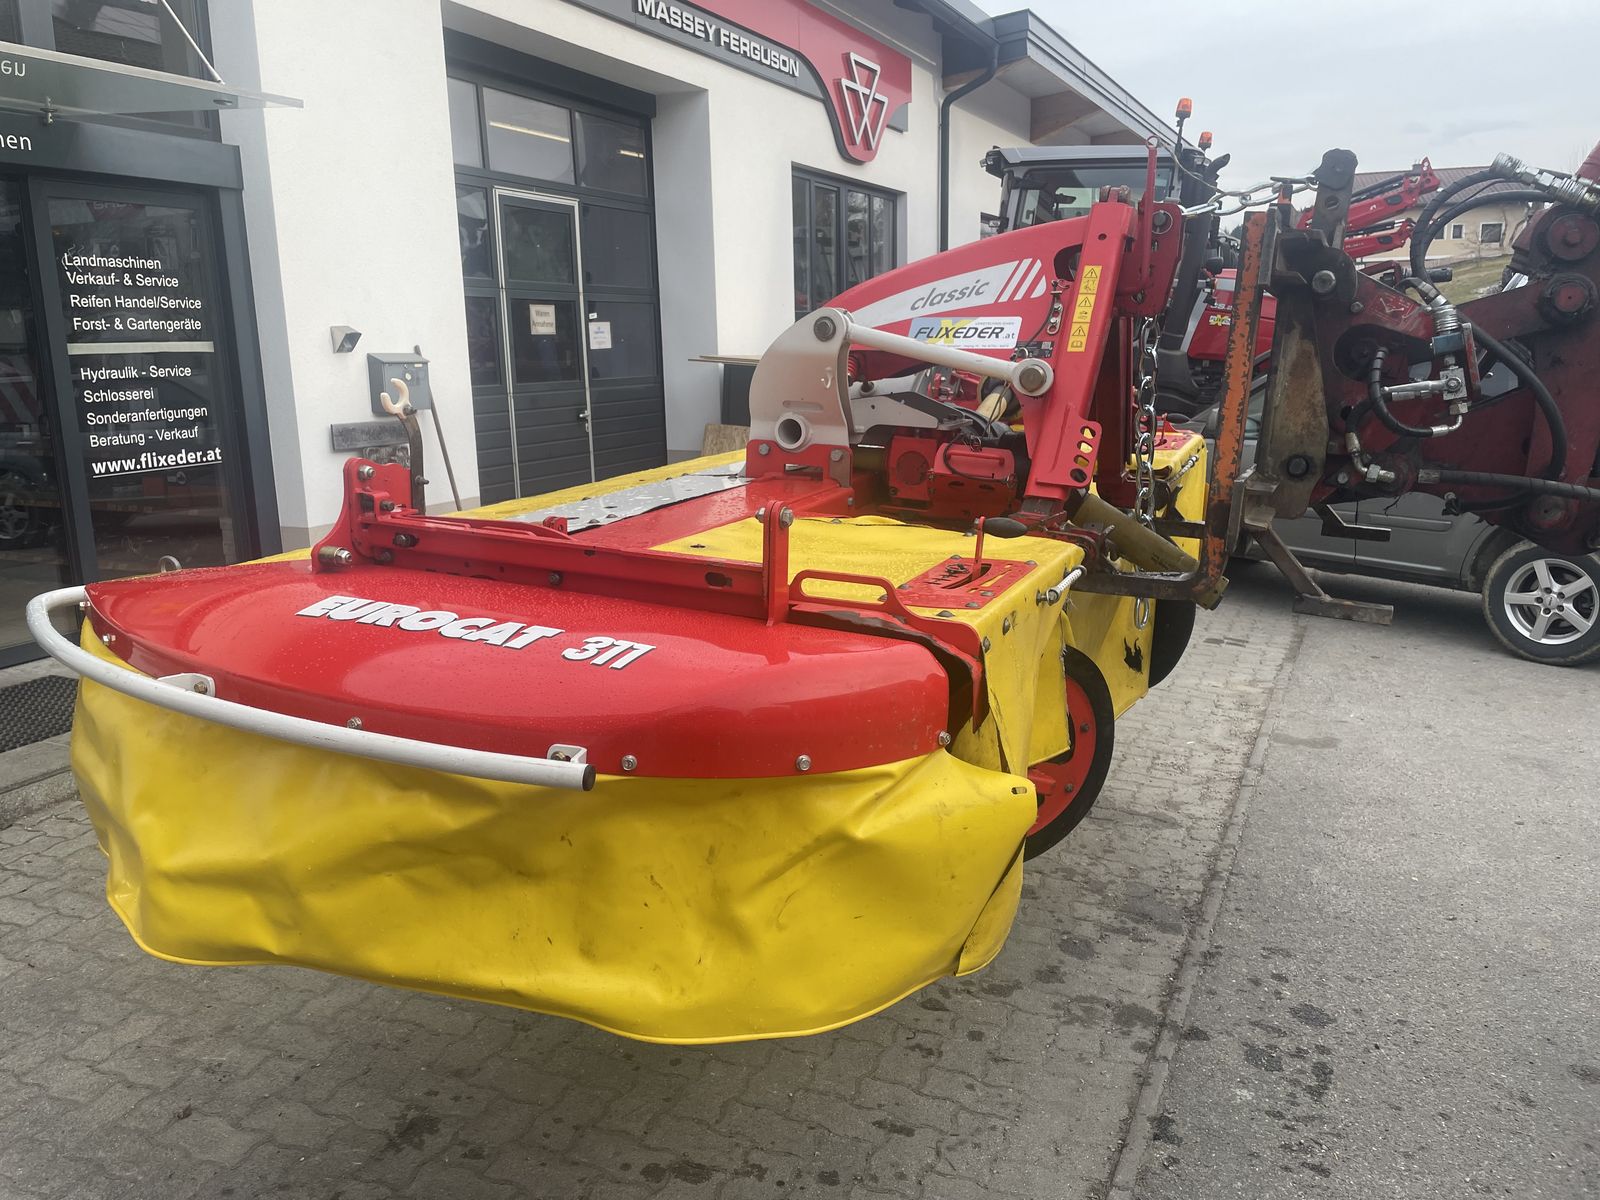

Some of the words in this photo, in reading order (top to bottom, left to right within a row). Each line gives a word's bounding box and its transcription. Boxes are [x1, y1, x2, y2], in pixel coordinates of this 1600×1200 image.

[637, 0, 716, 41] MASSEY
[720, 31, 799, 77] FERGUSON
[64, 253, 161, 269] Landmaschinen
[66, 271, 121, 285] Verkauf-
[123, 273, 133, 286] &
[135, 274, 179, 288] Service
[70, 295, 111, 308] Reifen
[115, 295, 202, 309] Handel/Service
[910, 279, 990, 311] classic
[73, 317, 111, 331] Forst-
[114, 317, 124, 331] &
[126, 317, 202, 333] Gartengeräte
[80, 366, 139, 383] Hydraulik
[149, 365, 192, 378] Service
[84, 388, 154, 403] Schlosserei
[86, 407, 208, 425] Sonderanfertigungen
[89, 434, 146, 448] Beratung
[155, 425, 199, 442] Verkauf
[92, 447, 222, 475] www.flixeder.at
[295, 595, 565, 649] EUROCAT
[562, 636, 656, 670] 311
